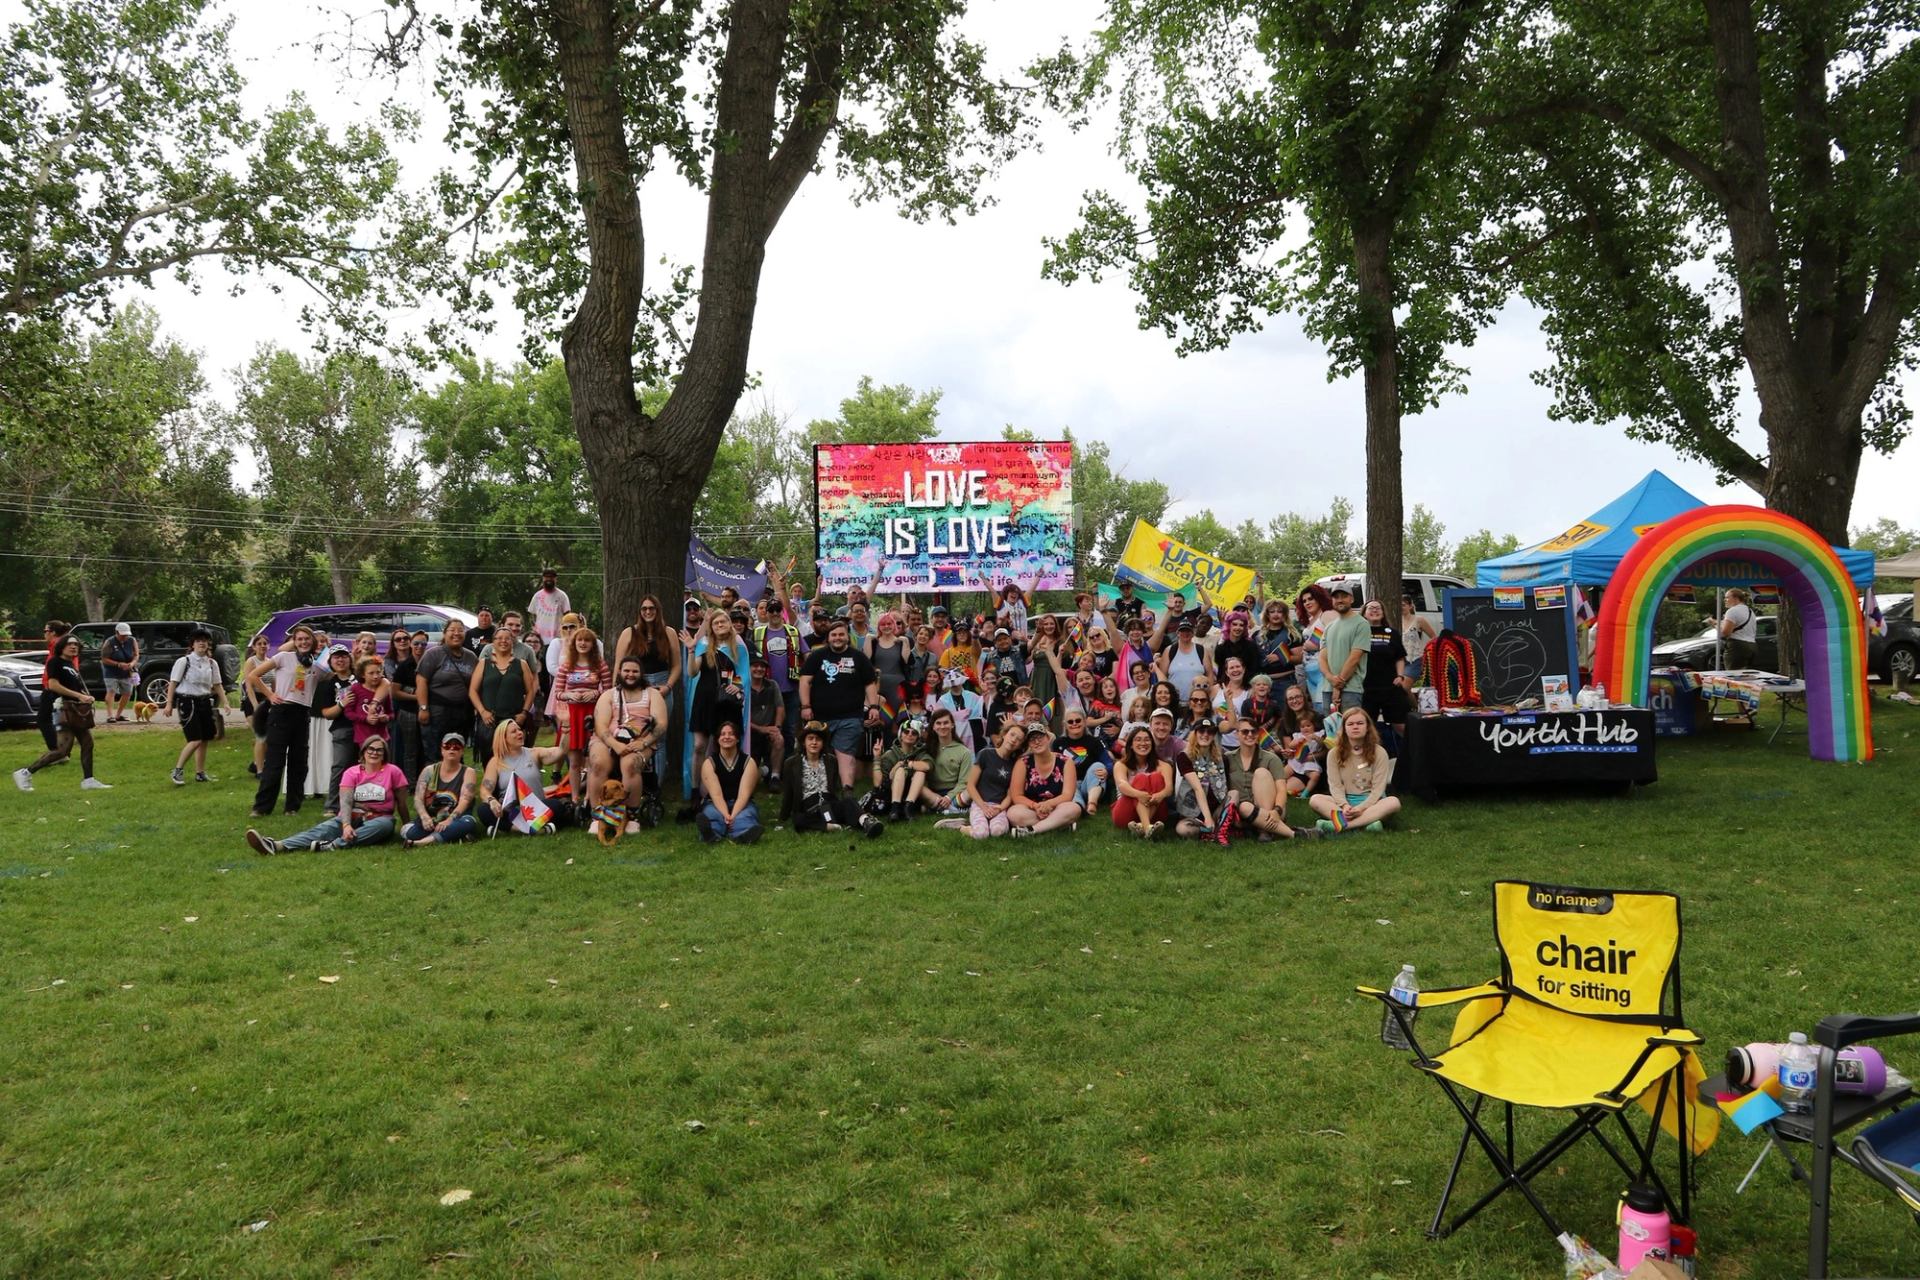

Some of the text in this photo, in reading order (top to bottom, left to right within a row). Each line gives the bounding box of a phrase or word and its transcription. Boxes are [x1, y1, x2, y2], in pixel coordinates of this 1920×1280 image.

[904, 470, 988, 508] LOVE
[884, 516, 1012, 555] IS LOVE
[715, 568, 747, 580] COUNCIL
[825, 576, 868, 587] gugma
[894, 574, 931, 586] gugm
[1164, 541, 1234, 583] UFCW
[1479, 712, 1639, 754] Youth Hub
[1536, 893, 1552, 904] no
[1536, 934, 1636, 975] chair
[1537, 975, 1631, 1008] for sitting
